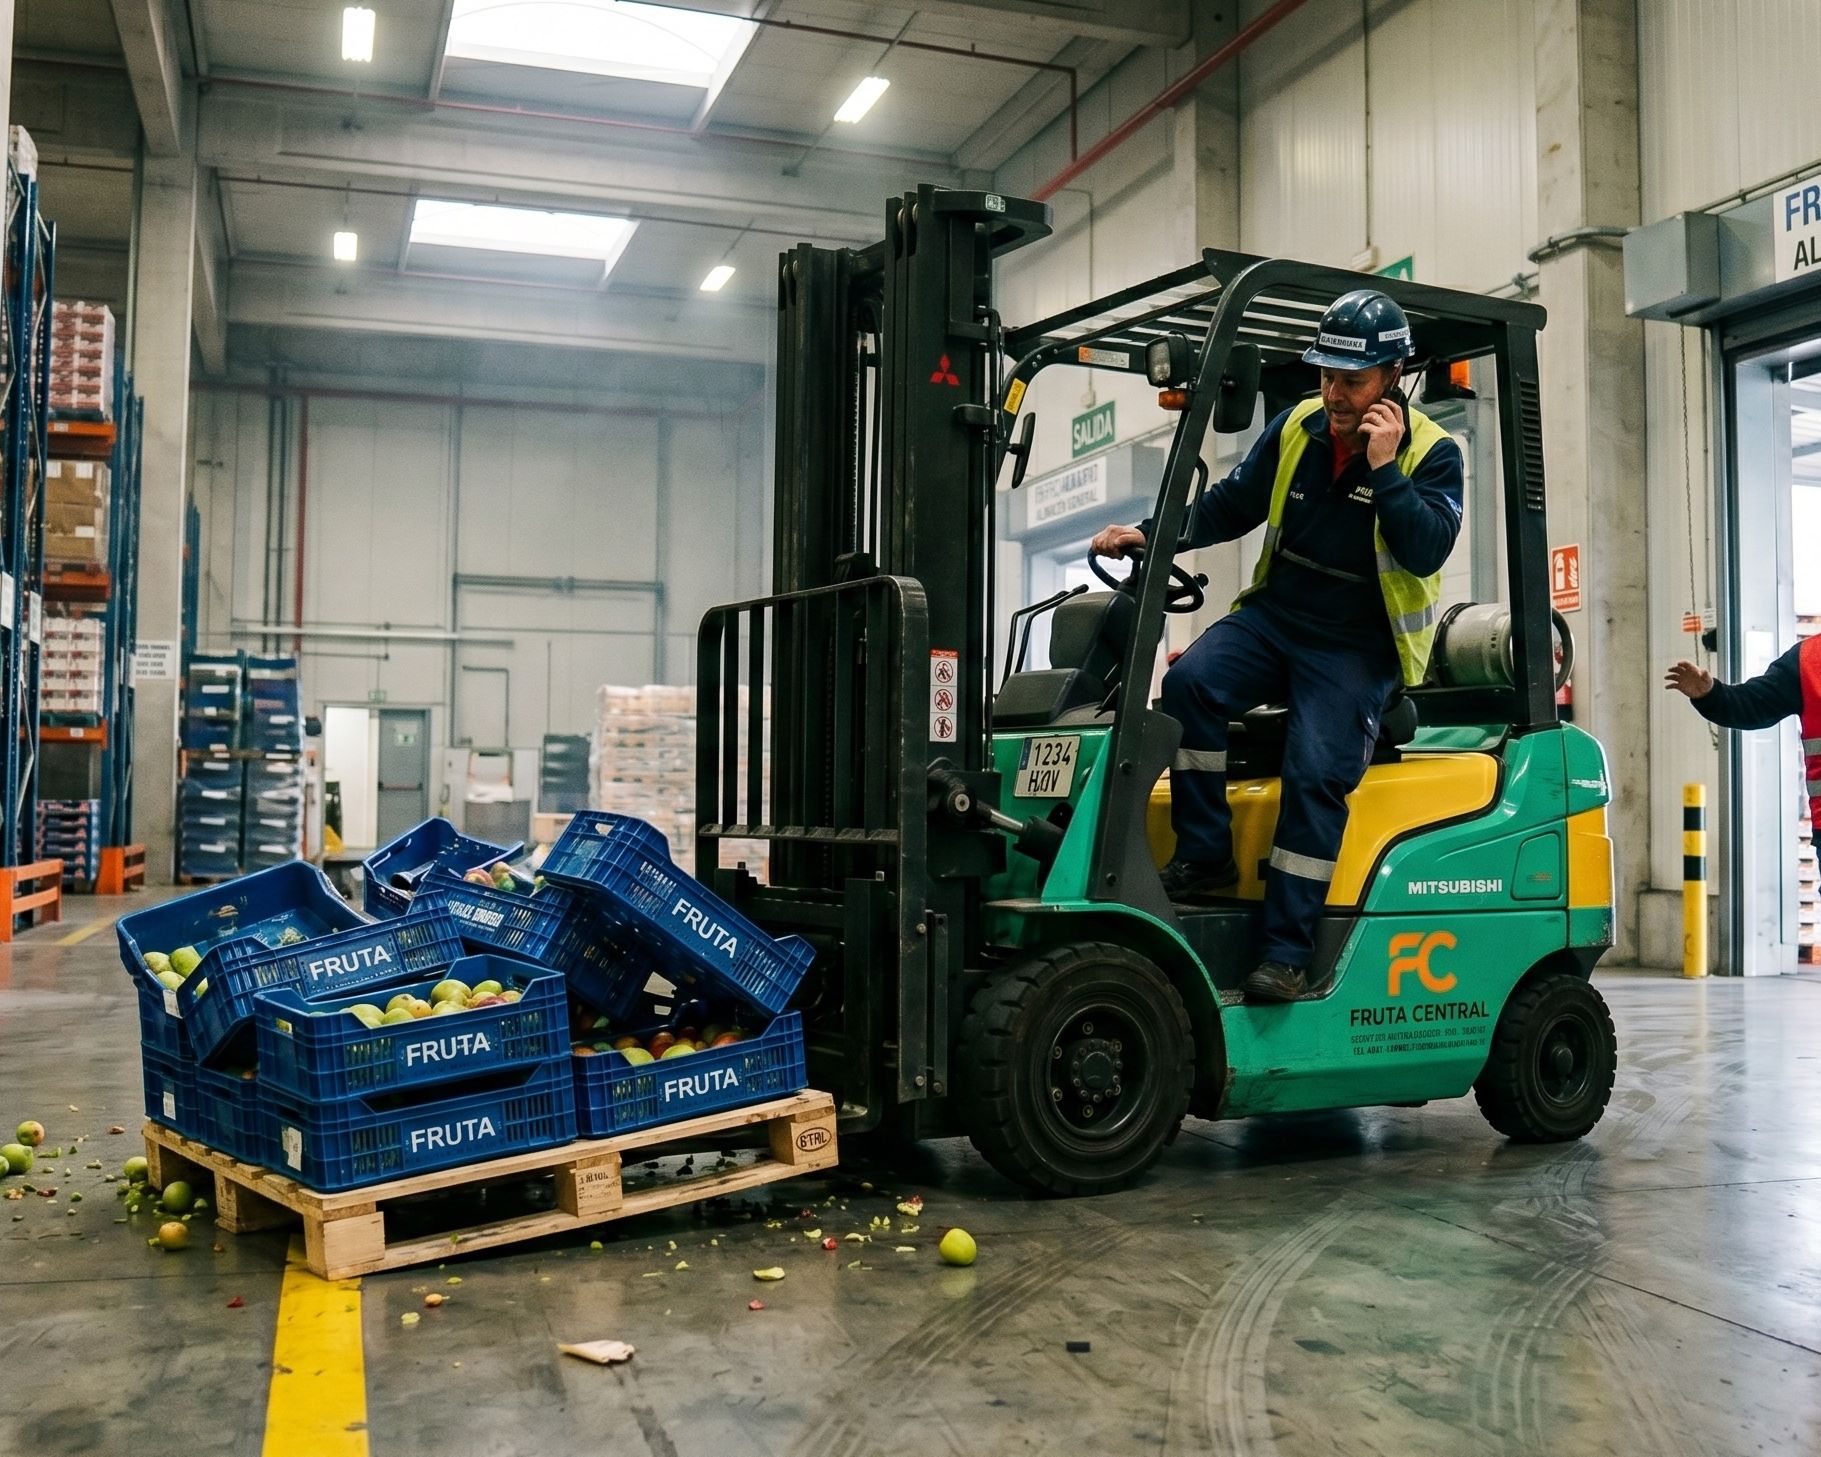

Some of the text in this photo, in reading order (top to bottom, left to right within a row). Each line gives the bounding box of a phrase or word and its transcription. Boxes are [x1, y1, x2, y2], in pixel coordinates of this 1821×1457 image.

[1794, 236, 1821, 271] AL
[1073, 410, 1112, 450] SALIDA
[1035, 742, 1072, 766] 1234
[1408, 879, 1502, 894] MITSUBISHI
[672, 898, 738, 959] FRUTA
[309, 945, 392, 980] FRUTA
[1388, 930, 1457, 997] FC
[1350, 1001, 1490, 1027] FRUTA CENTRAL
[406, 1032, 491, 1067] FRUTA
[664, 1067, 739, 1102] FRUTA
[411, 1116, 496, 1153] FRUTA
